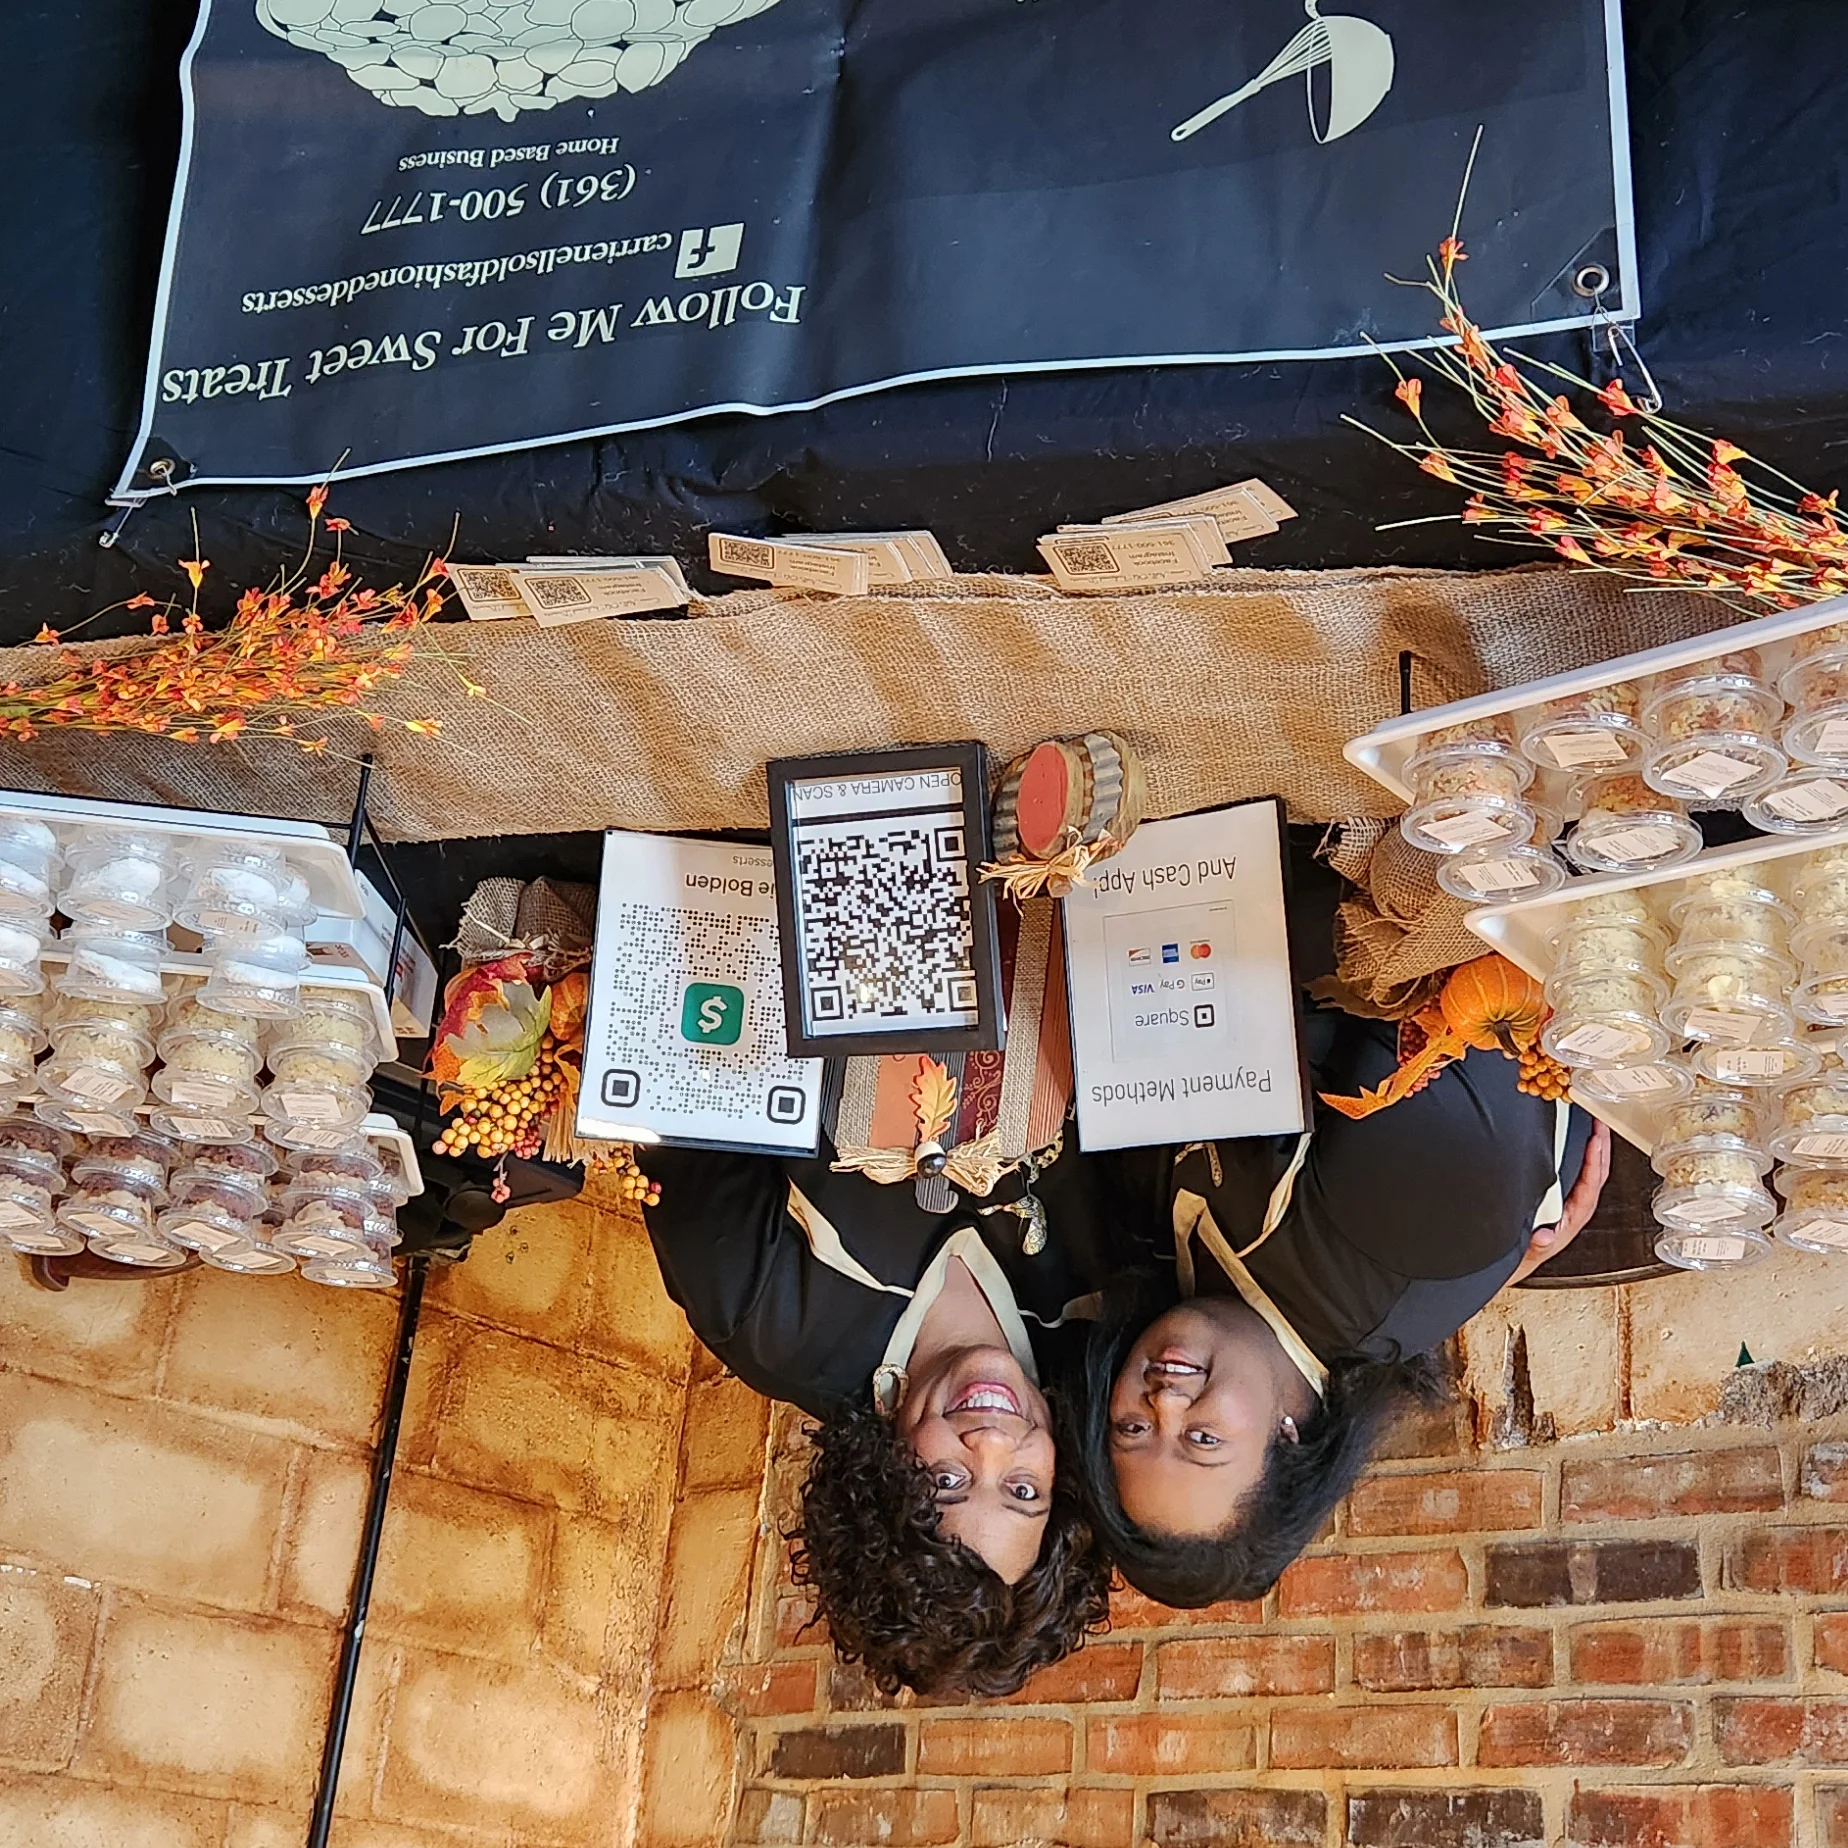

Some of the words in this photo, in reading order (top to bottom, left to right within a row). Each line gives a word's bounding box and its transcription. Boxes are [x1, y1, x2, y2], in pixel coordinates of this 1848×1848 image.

[398, 148, 486, 173] Business
[491, 144, 551, 169] Based
[555, 137, 620, 157] Home
[540, 163, 637, 209] (361)
[360, 182, 529, 235] 500-1777
[241, 231, 673, 315] carrienellsoldfashioneddesserts
[630, 281, 807, 330] Follow
[451, 315, 536, 358] For
[547, 303, 623, 348] Me
[305, 330, 442, 385] Sweet
[162, 357, 292, 405] Treats
[792, 785, 833, 802] SCAN
[836, 783, 847, 797] &
[850, 777, 915, 796] CAMERA
[919, 772, 962, 789] OPEN
[732, 855, 773, 868] esserts
[1198, 857, 1237, 884] And
[686, 874, 753, 897] Bolden
[1092, 868, 1136, 899] App!
[1142, 863, 1191, 893] Cash
[1131, 984, 1155, 995] VISA
[1159, 979, 1175, 990] Pay
[1134, 1008, 1190, 1028] Square
[1091, 1078, 1174, 1107] Methods
[1181, 1066, 1272, 1098] Payment
